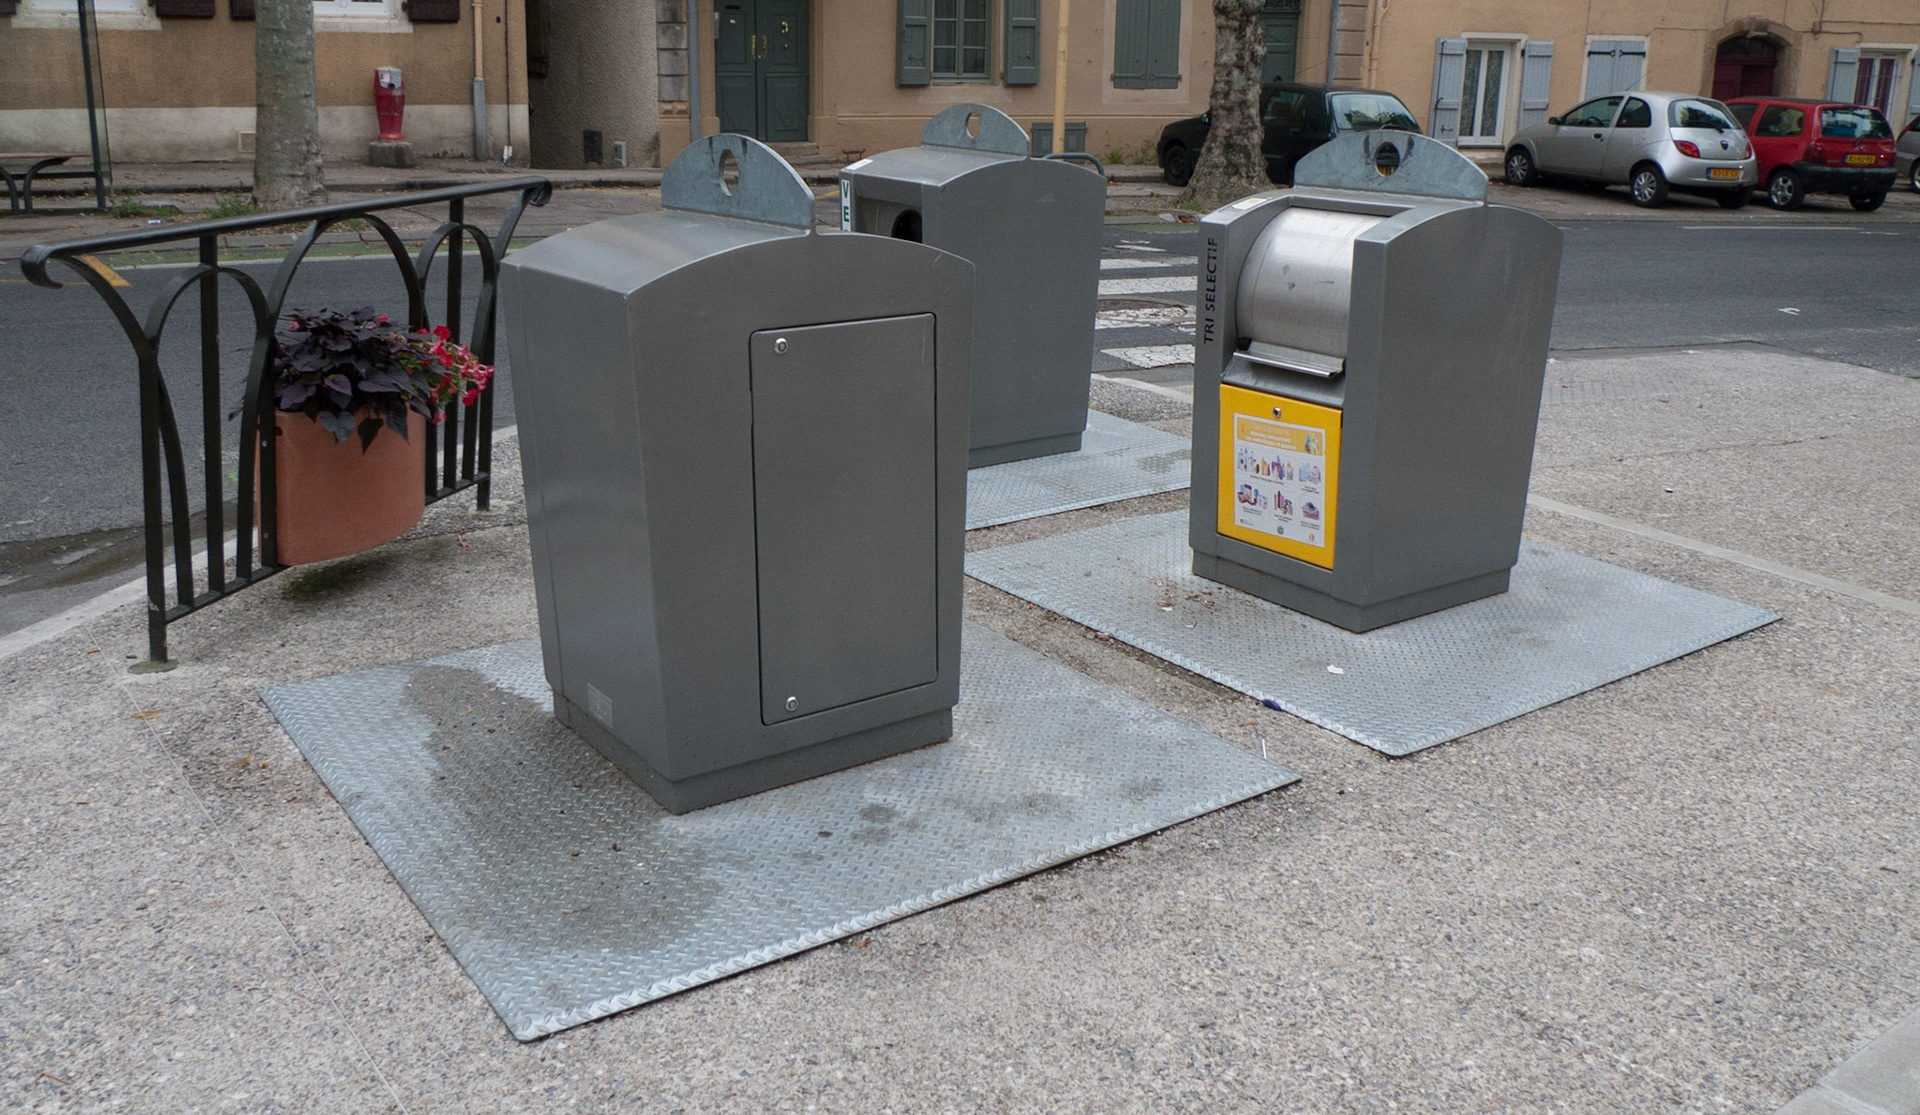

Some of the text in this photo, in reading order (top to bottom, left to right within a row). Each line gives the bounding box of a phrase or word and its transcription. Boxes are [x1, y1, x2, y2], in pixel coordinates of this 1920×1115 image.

[842, 181, 850, 231] VE
[1204, 237, 1218, 344] TRI SELECTIF
